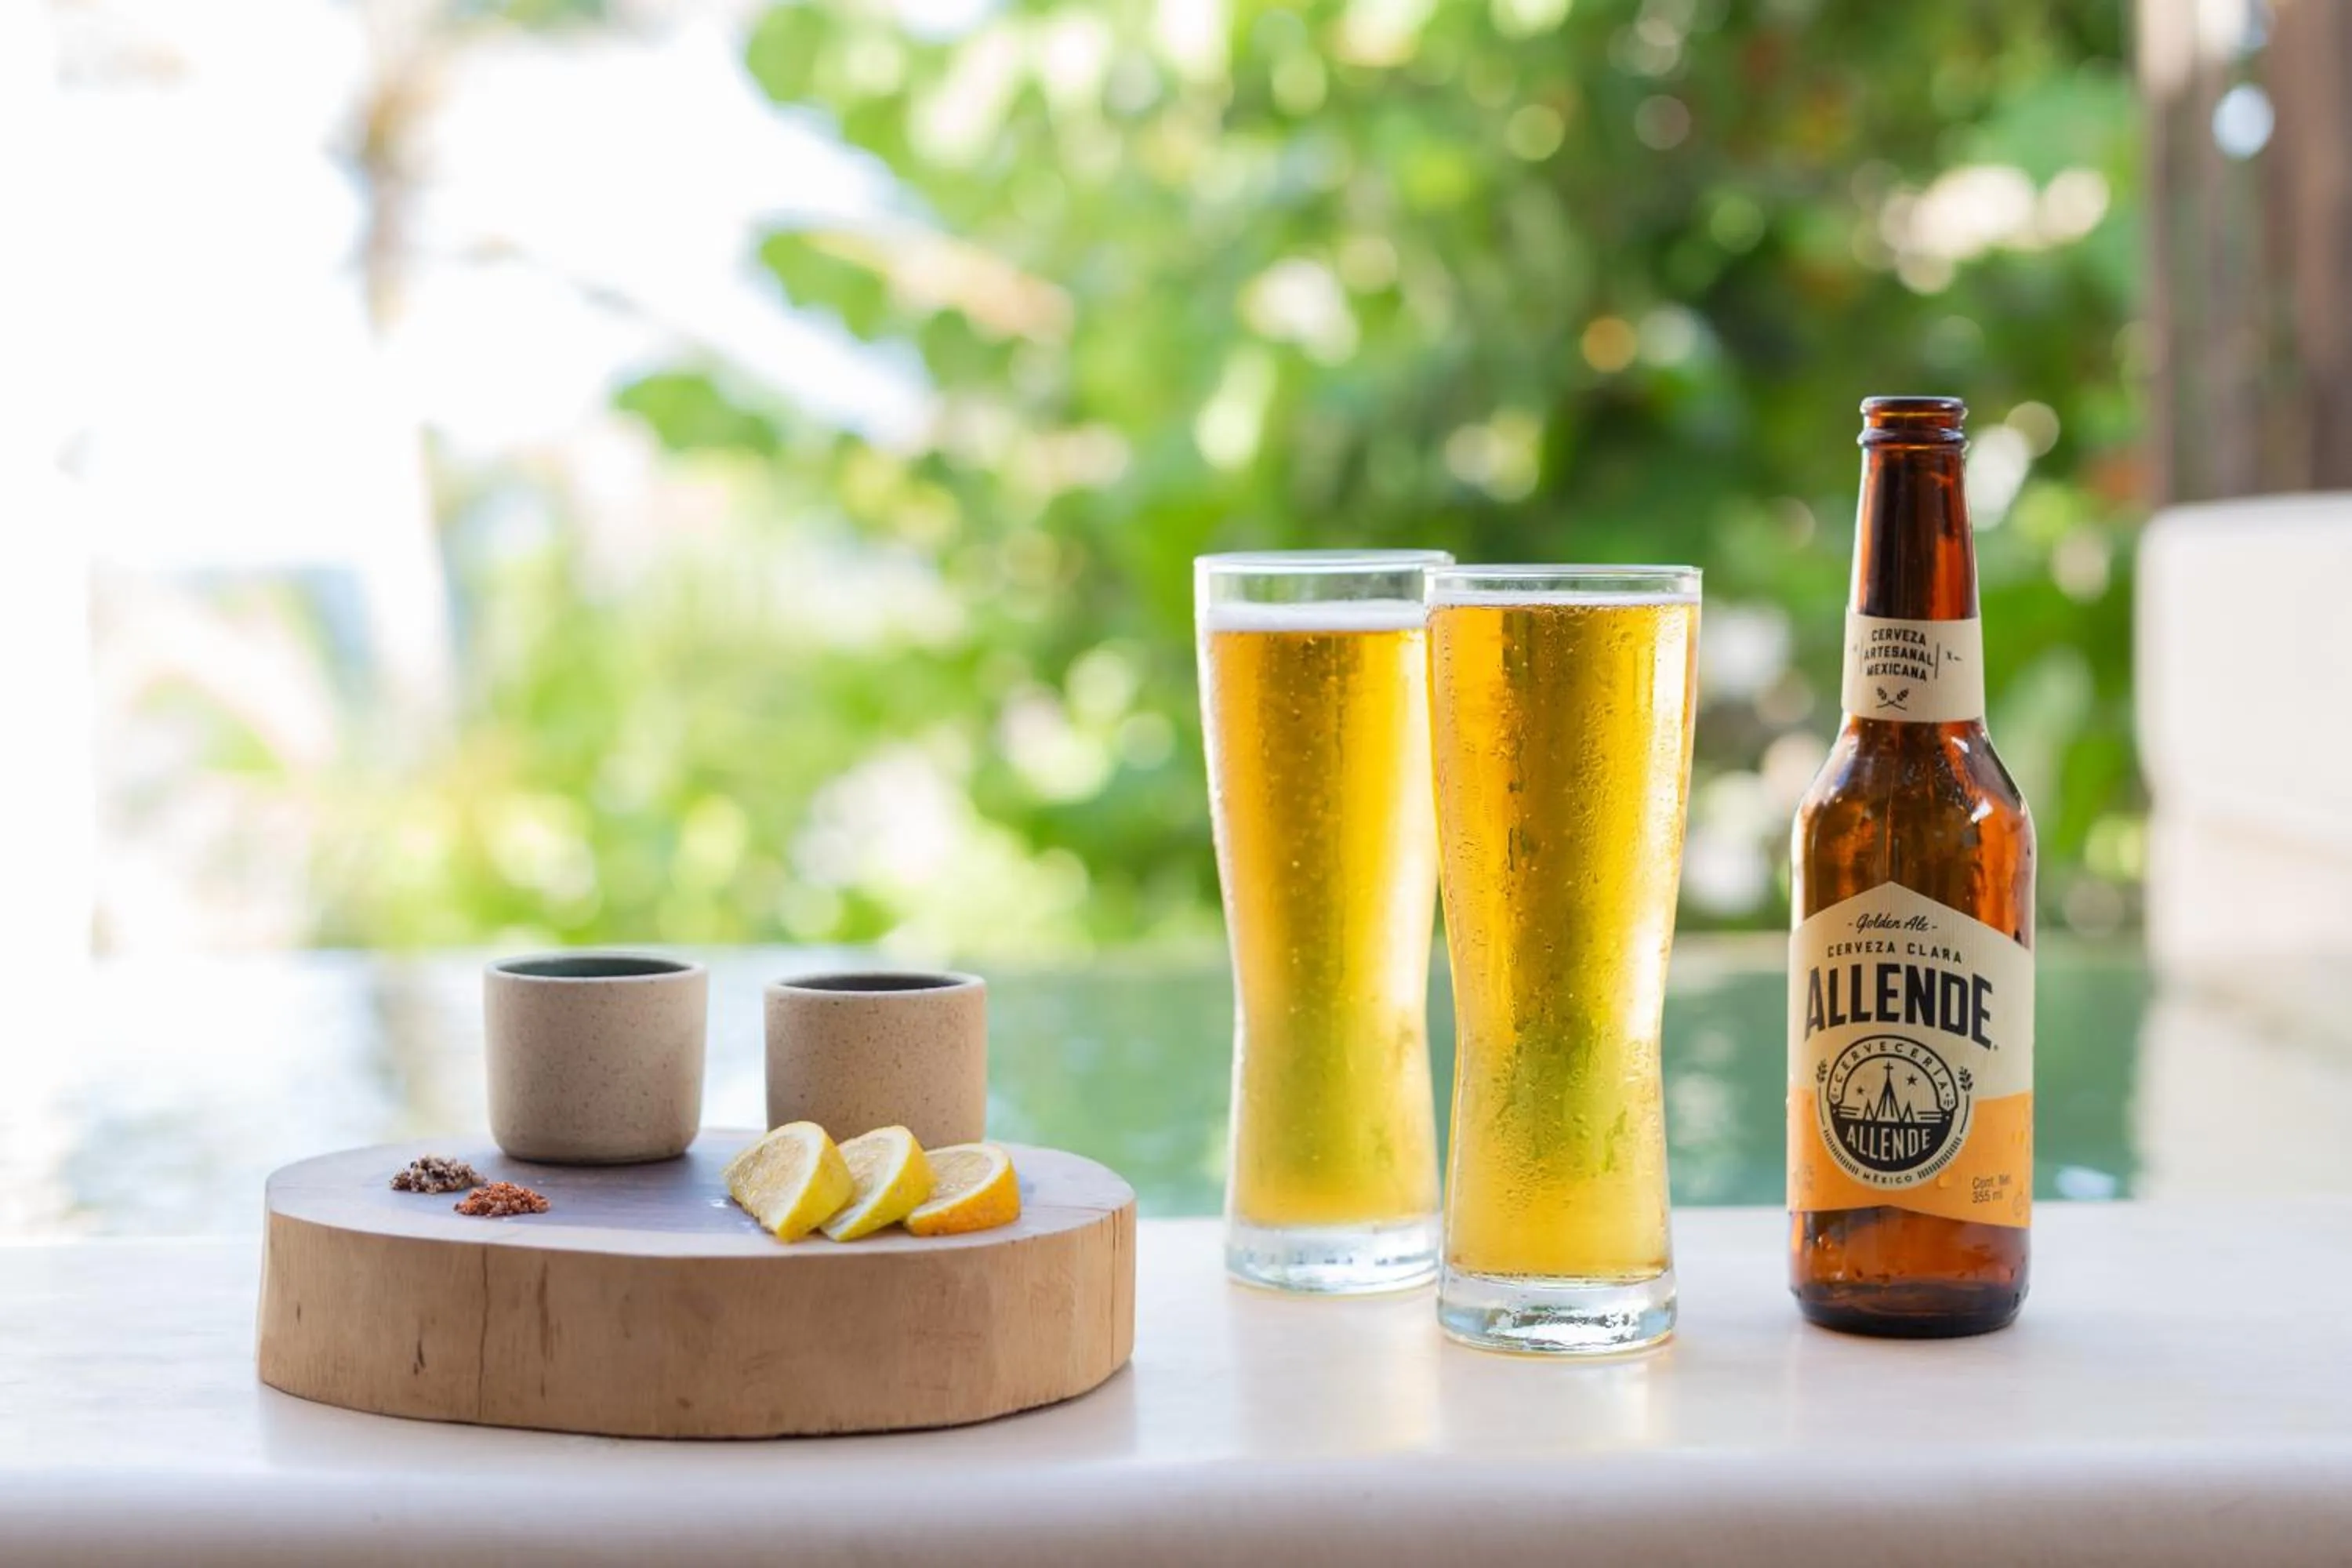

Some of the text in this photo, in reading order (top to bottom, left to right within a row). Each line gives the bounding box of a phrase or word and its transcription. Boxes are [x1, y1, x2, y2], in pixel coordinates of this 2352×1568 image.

[1871, 628, 1926, 646] CERVEZA
[1864, 645, 1934, 667] ARTESANAL
[1866, 662, 1927, 682] MEXICANA
[1856, 913, 1929, 934] Golden Ale
[1828, 941, 1962, 964] CERVEZA CLARA
[1805, 963, 1993, 1051] ALLENDE
[1846, 1124, 1932, 1162] ALLENDE
